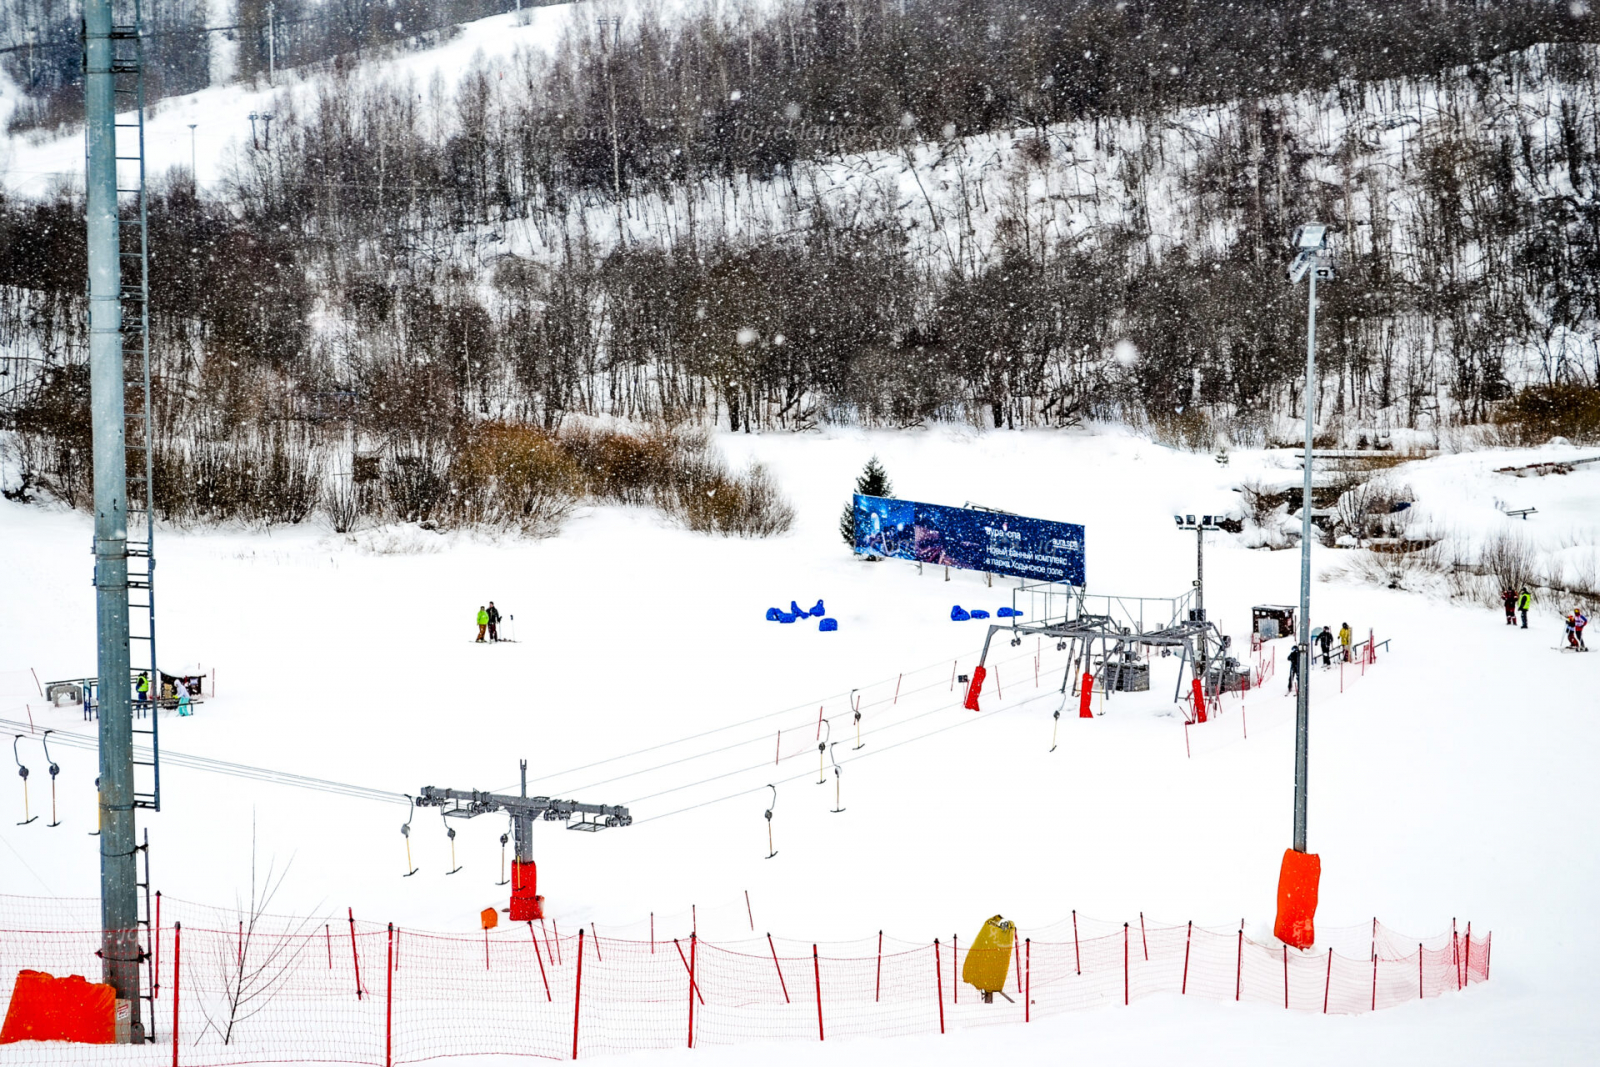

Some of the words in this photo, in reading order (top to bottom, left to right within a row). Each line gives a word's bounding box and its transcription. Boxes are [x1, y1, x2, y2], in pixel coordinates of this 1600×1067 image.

[986, 545, 1007, 556] Новый
[1035, 554, 1067, 566] комплекс
[1011, 559, 1046, 573] Ходынское
[1047, 567, 1063, 576] поле
